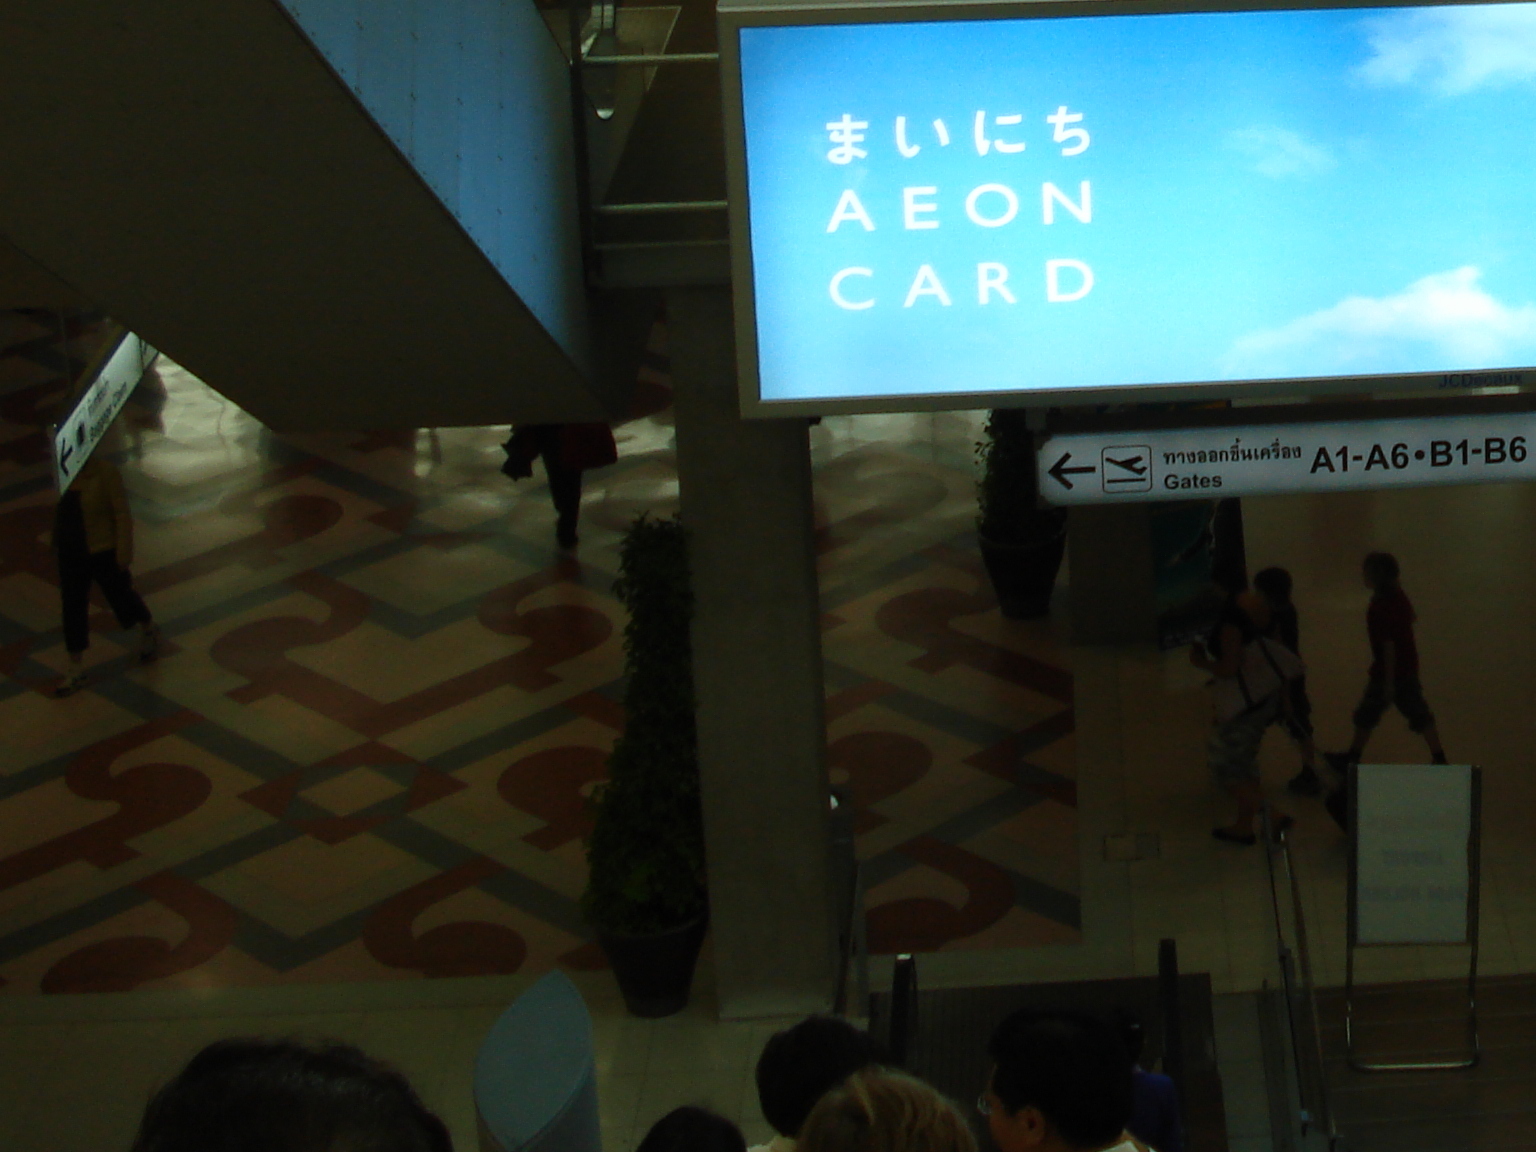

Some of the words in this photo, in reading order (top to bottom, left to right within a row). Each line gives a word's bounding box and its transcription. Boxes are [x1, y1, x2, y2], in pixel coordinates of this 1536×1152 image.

[825, 105, 1091, 165] まいにち
[825, 180, 1093, 234] AEON
[828, 257, 1095, 311] CARD
[1164, 473, 1224, 490] Gates
